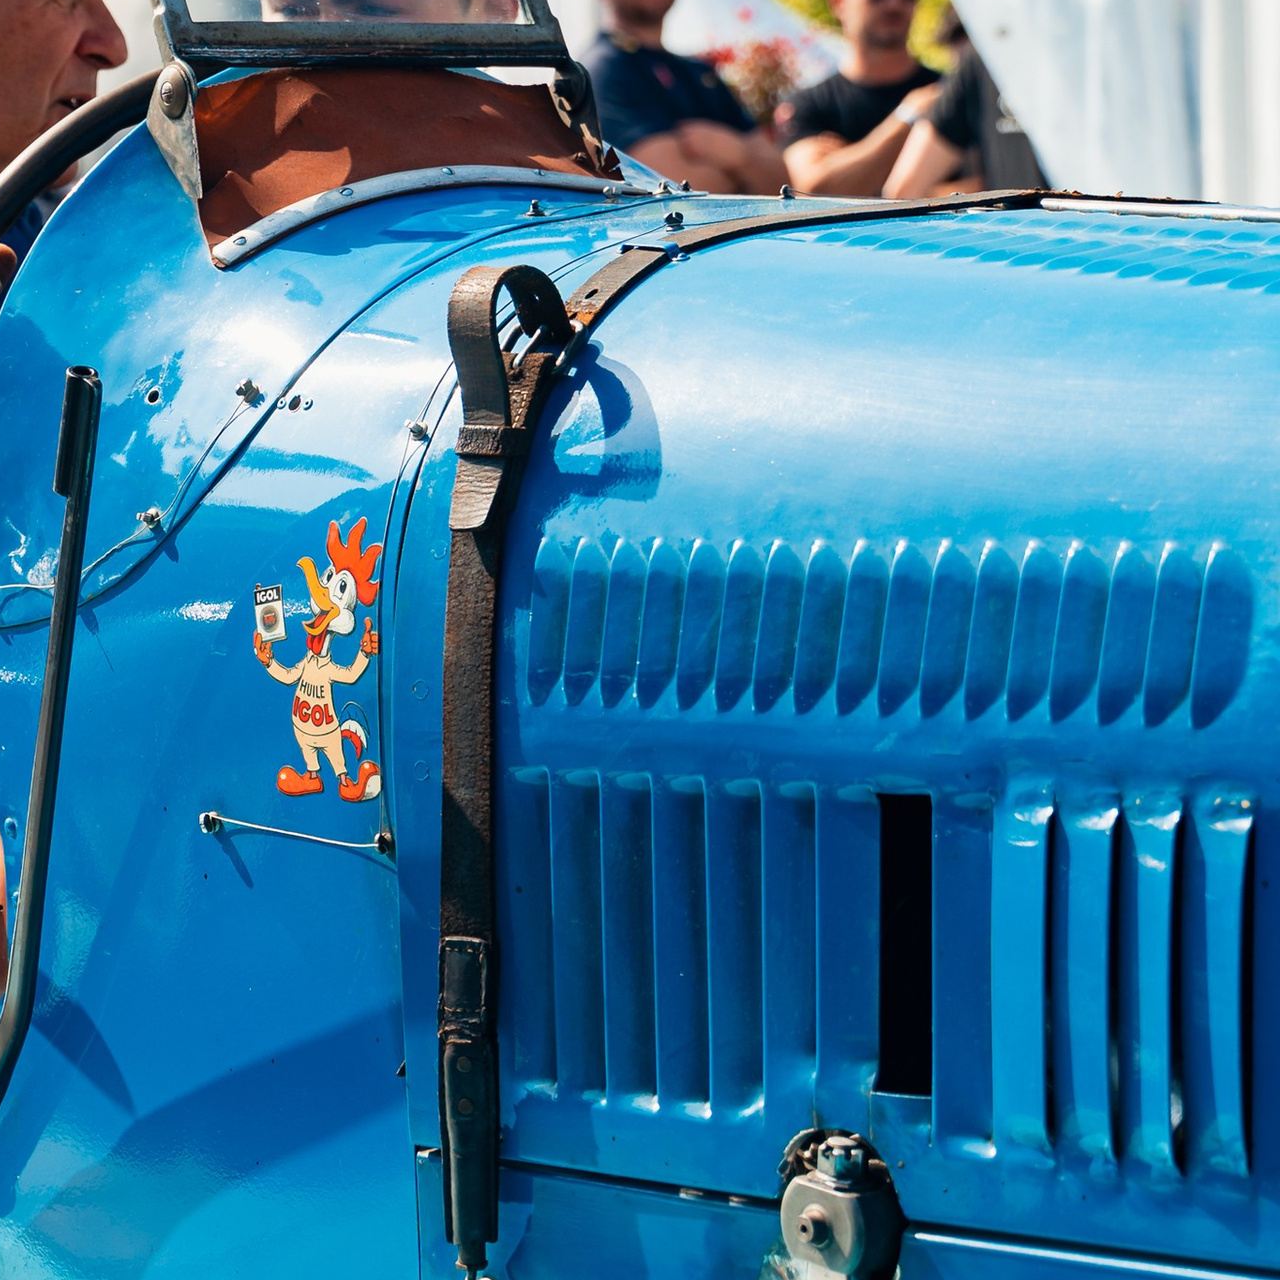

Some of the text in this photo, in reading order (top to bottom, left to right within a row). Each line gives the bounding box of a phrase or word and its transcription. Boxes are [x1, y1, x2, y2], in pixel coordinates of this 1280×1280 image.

[256, 588, 279, 604] IGOL
[300, 679, 325, 699] HUILE
[293, 695, 335, 727] IGOL
